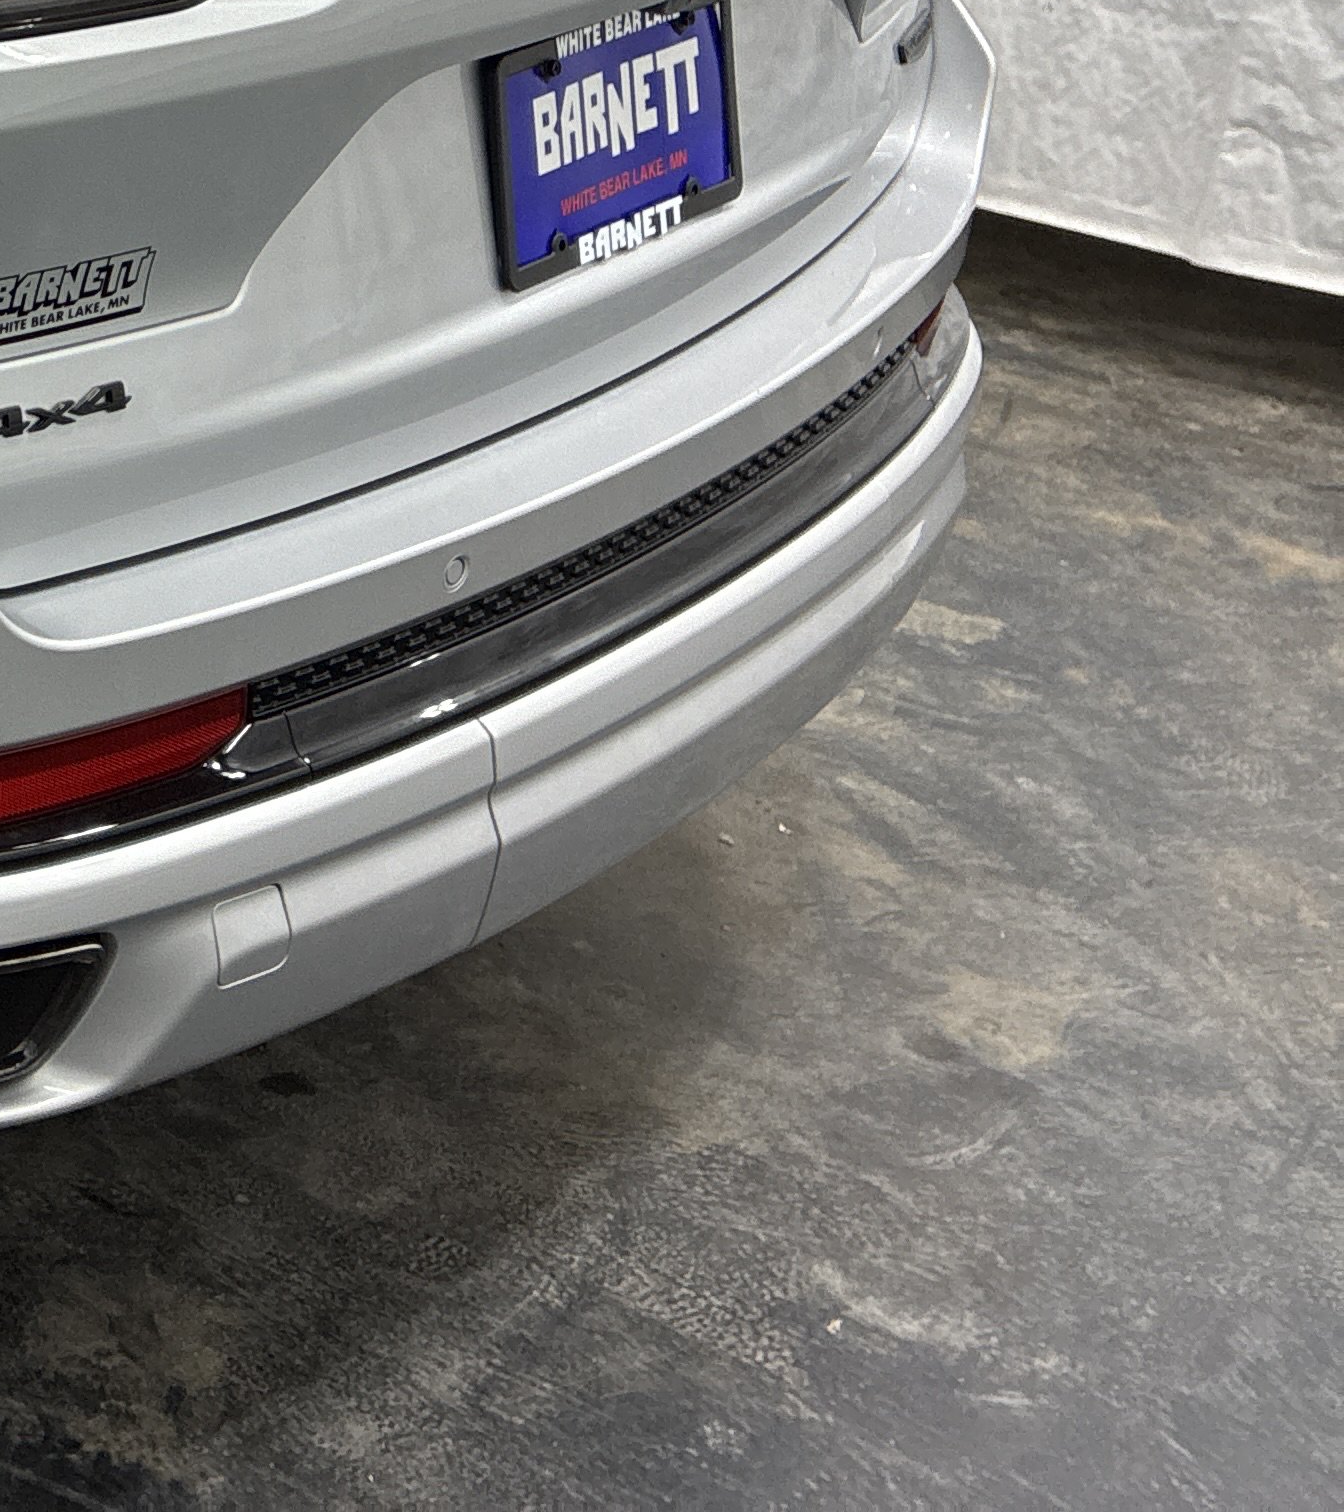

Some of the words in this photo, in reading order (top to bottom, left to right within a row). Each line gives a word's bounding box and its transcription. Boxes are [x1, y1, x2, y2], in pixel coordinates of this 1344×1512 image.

[555, 23, 603, 59] WHITE
[604, 9, 642, 44] BEAR
[532, 36, 700, 177] BARNETT
[560, 185, 598, 217] WHITE
[599, 170, 631, 201] BEAR
[669, 148, 689, 170] MN
[578, 194, 684, 266] BARNETT
[31, 310, 65, 328] BEAR
[68, 301, 106, 320] LAKE,
[107, 293, 131, 310] MN
